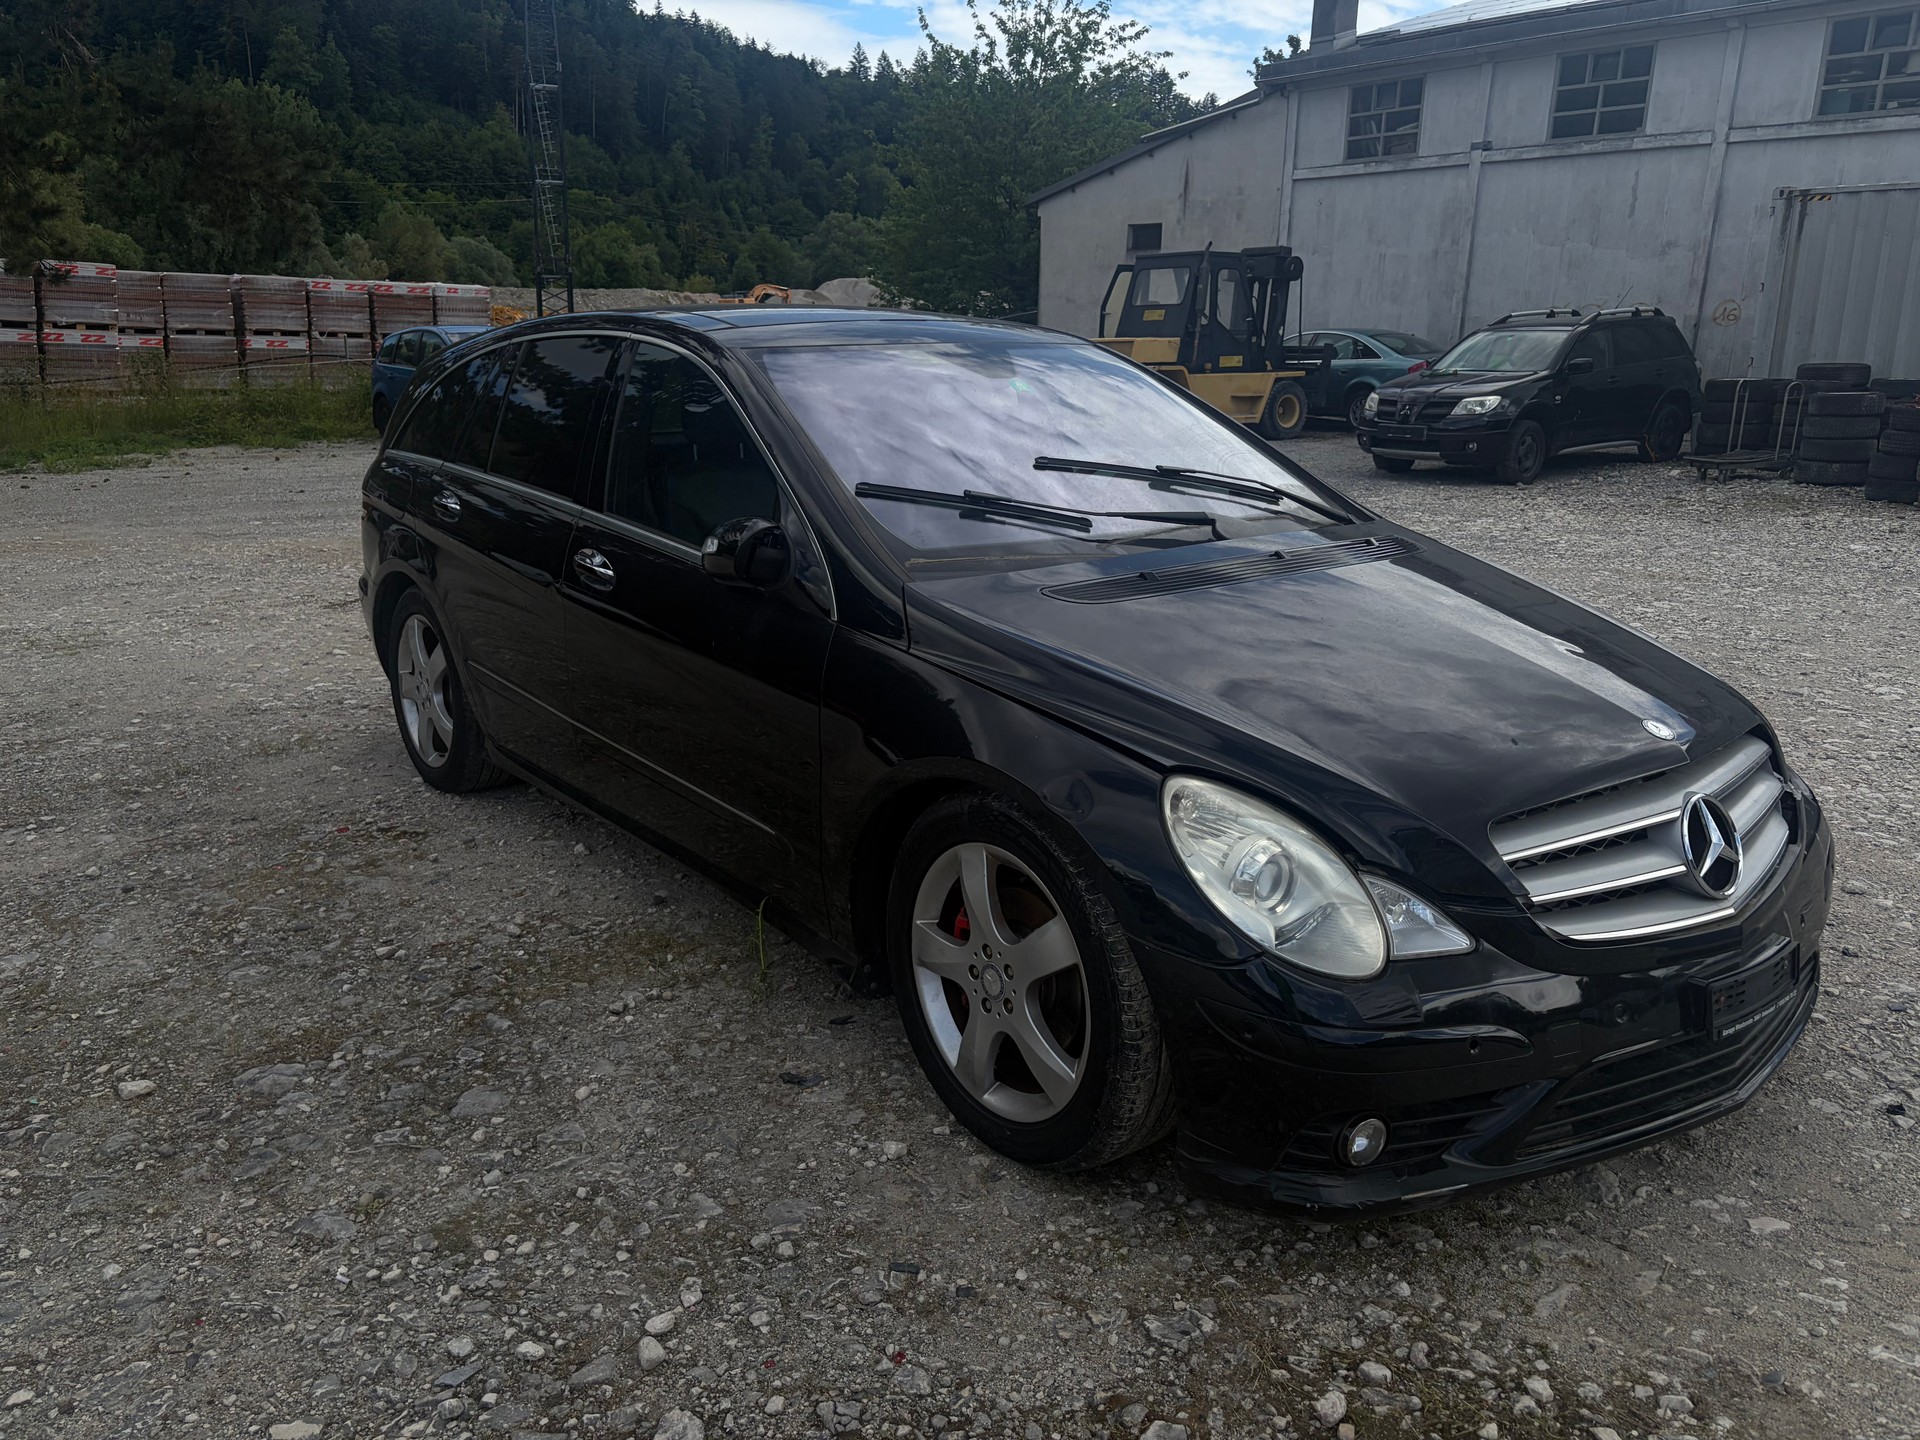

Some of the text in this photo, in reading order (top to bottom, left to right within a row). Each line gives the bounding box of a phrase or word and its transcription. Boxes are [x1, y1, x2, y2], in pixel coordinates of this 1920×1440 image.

[311, 280, 368, 293] ZZ ZZ
[374, 284, 394, 293] ZZ
[407, 286, 430, 295] ZZ
[1713, 307, 1737, 321] 16
[80, 333, 106, 343] ZZ
[265, 339, 288, 348] ZZ
